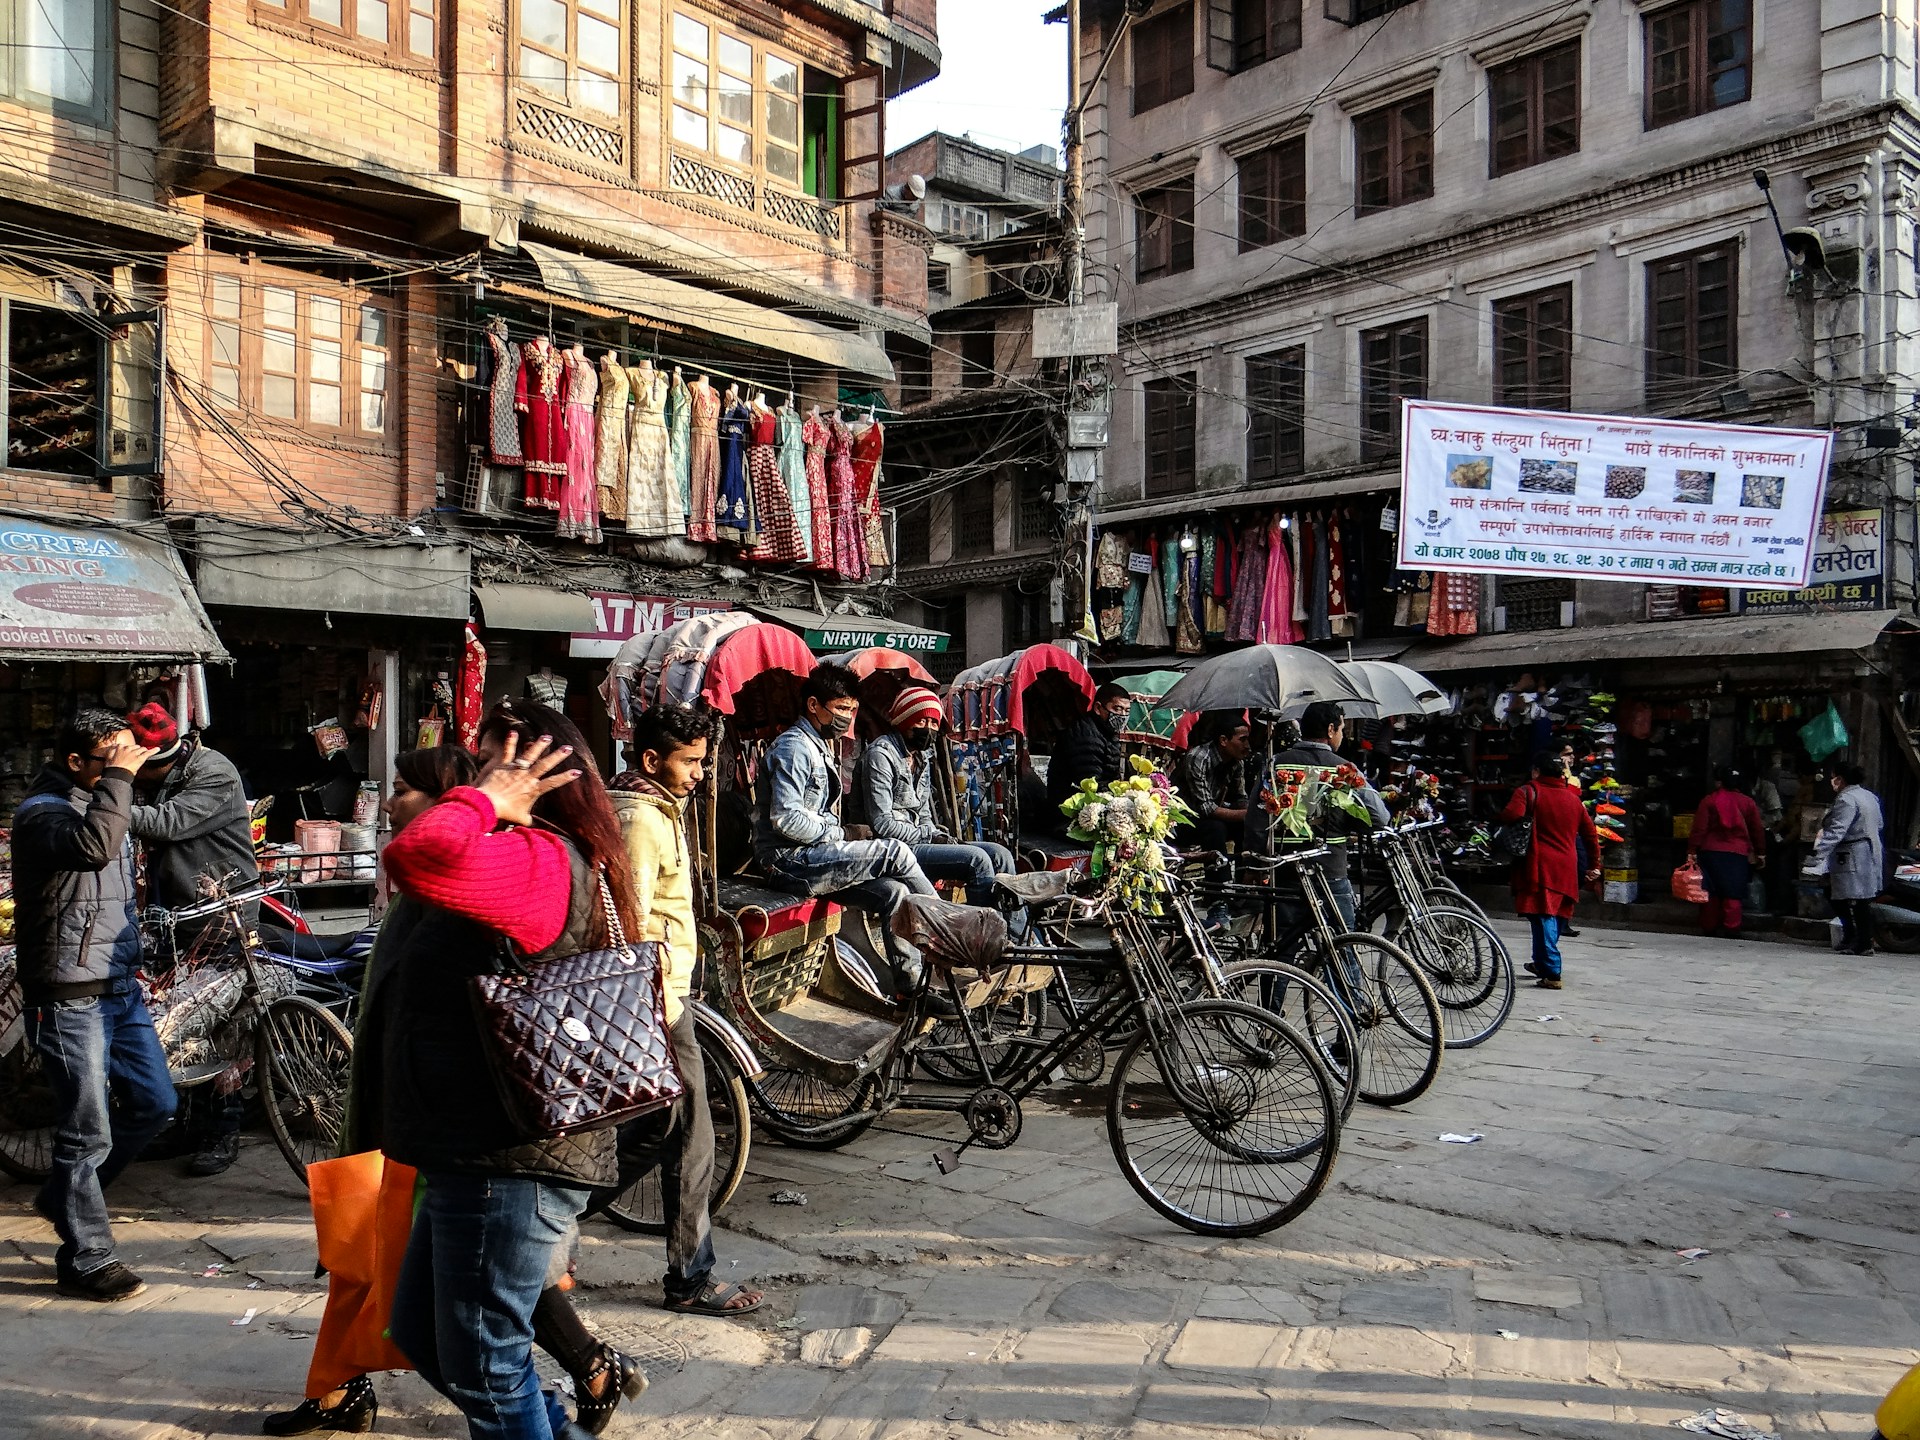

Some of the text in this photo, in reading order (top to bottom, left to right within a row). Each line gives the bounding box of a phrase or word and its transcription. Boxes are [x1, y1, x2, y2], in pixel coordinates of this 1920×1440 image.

[1624, 440, 1652, 456] माघे
[1658, 442, 1726, 461] संक्रान्तिको
[1732, 450, 1796, 470] शुभकामना
[1450, 496, 1474, 510] माघे
[1480, 498, 1525, 512] संक्रान्ति
[1530, 500, 1570, 516] पर्वलाई
[1608, 504, 1630, 520] गरी
[1636, 506, 1688, 526] राखिएको
[1692, 510, 1706, 524] यो
[1712, 514, 1739, 526] असन
[1480, 518, 1516, 537] सम्पूर्ण
[1620, 524, 1654, 542] हार्दिक
[1660, 532, 1695, 544] स्वागत
[1414, 542, 1429, 556] यो
[1433, 546, 1466, 560] बजार
[1469, 548, 1500, 560] २०७४
[1506, 546, 1526, 562] पौष
[1598, 555, 1614, 567] ३०
[1618, 556, 1628, 568] र
[1630, 556, 1654, 570] माघ
[1668, 556, 1686, 571] गते
[1691, 560, 1716, 574] सम्म
[1720, 562, 1743, 574] मात्र
[1747, 562, 1771, 576] रहने
[1774, 566, 1787, 576] छ
[1842, 585, 1862, 598] छ
[591, 598, 664, 633] ATM
[0, 629, 51, 643] ooked
[107, 632, 134, 646] etc.
[822, 632, 938, 649] NIRVIK STORE
